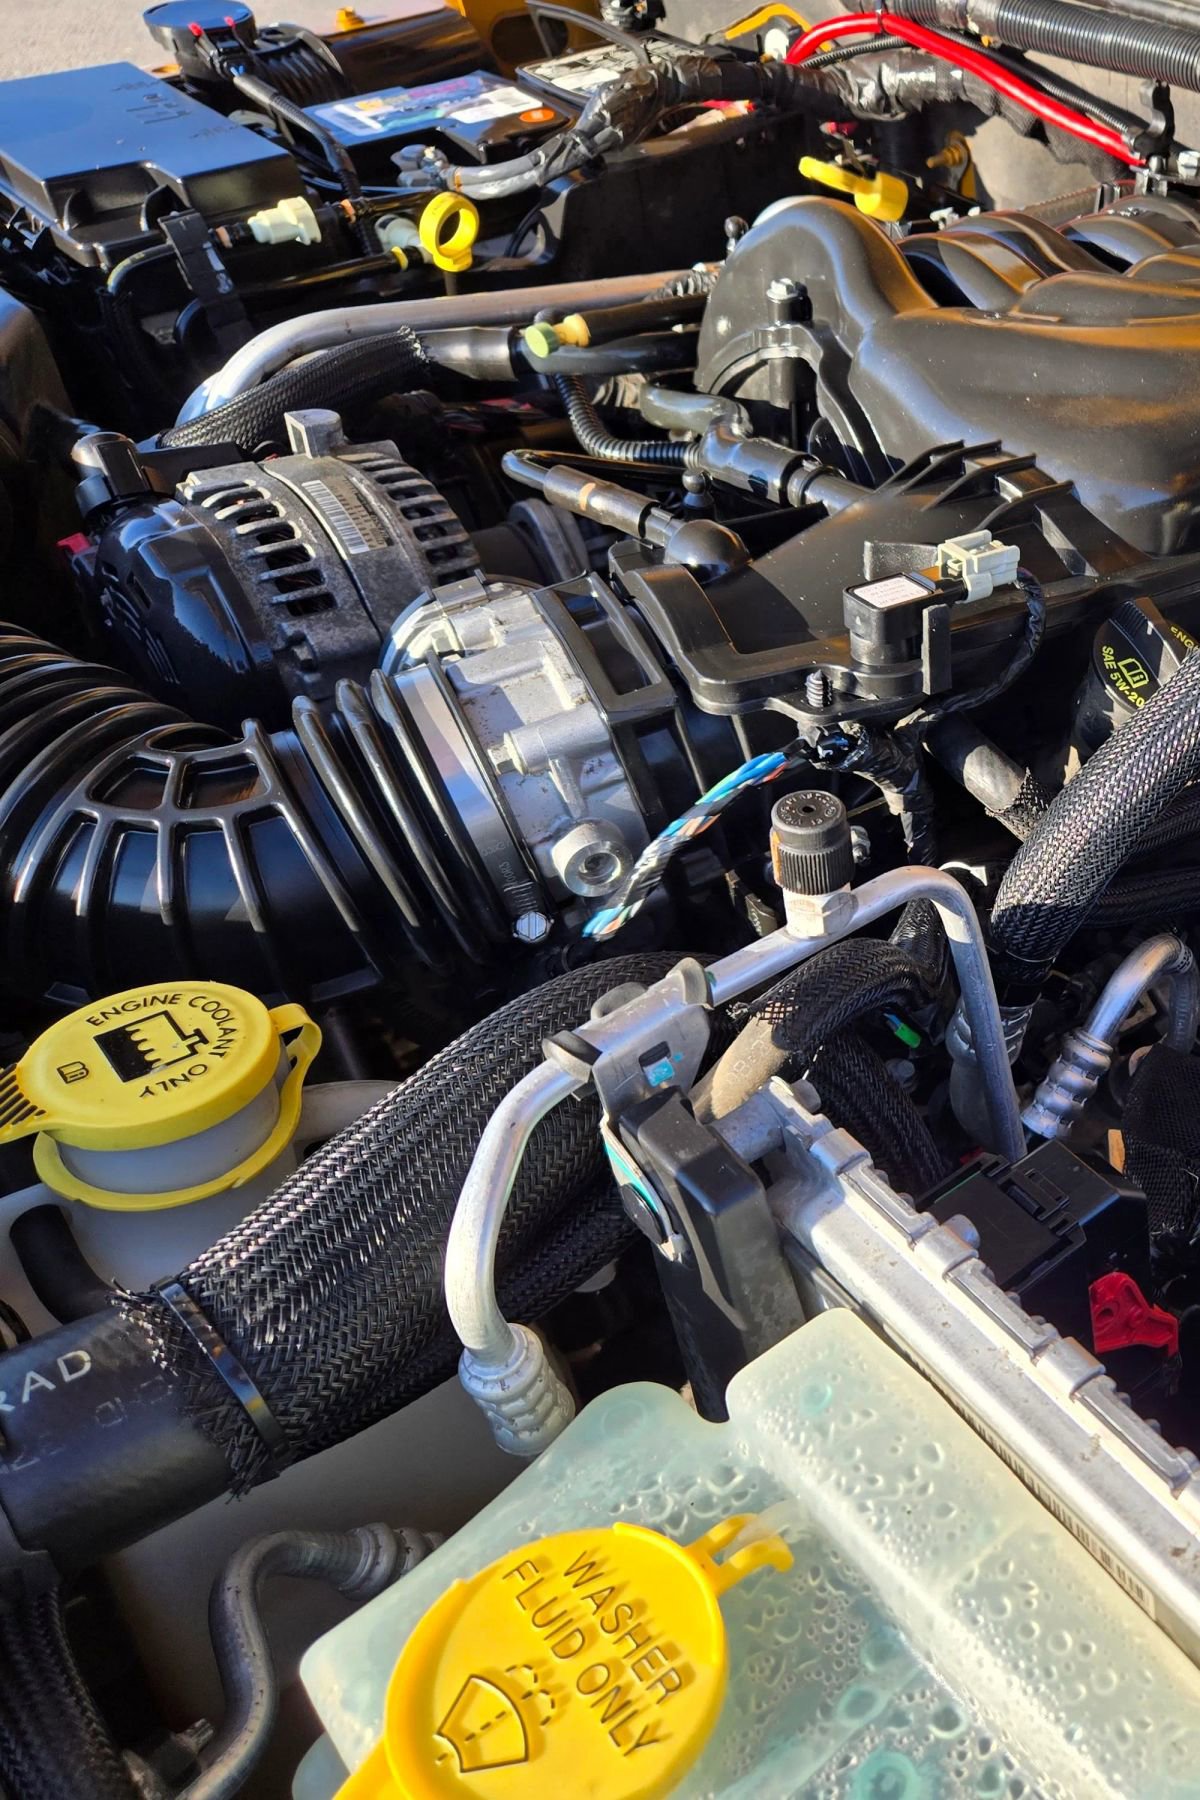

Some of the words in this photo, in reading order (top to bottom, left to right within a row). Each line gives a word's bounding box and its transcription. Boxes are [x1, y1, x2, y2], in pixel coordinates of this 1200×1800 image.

[1102, 645, 1117, 670] SAE
[1110, 672, 1145, 709] 5W-20
[85, 993, 184, 1027] ENGINE
[188, 995, 238, 1059] COOLANT
[139, 1063, 209, 1098] ONLY
[563, 1550, 683, 1705] WASHER
[502, 1559, 586, 1660] FLUID
[576, 1662, 660, 1757] ONLY
